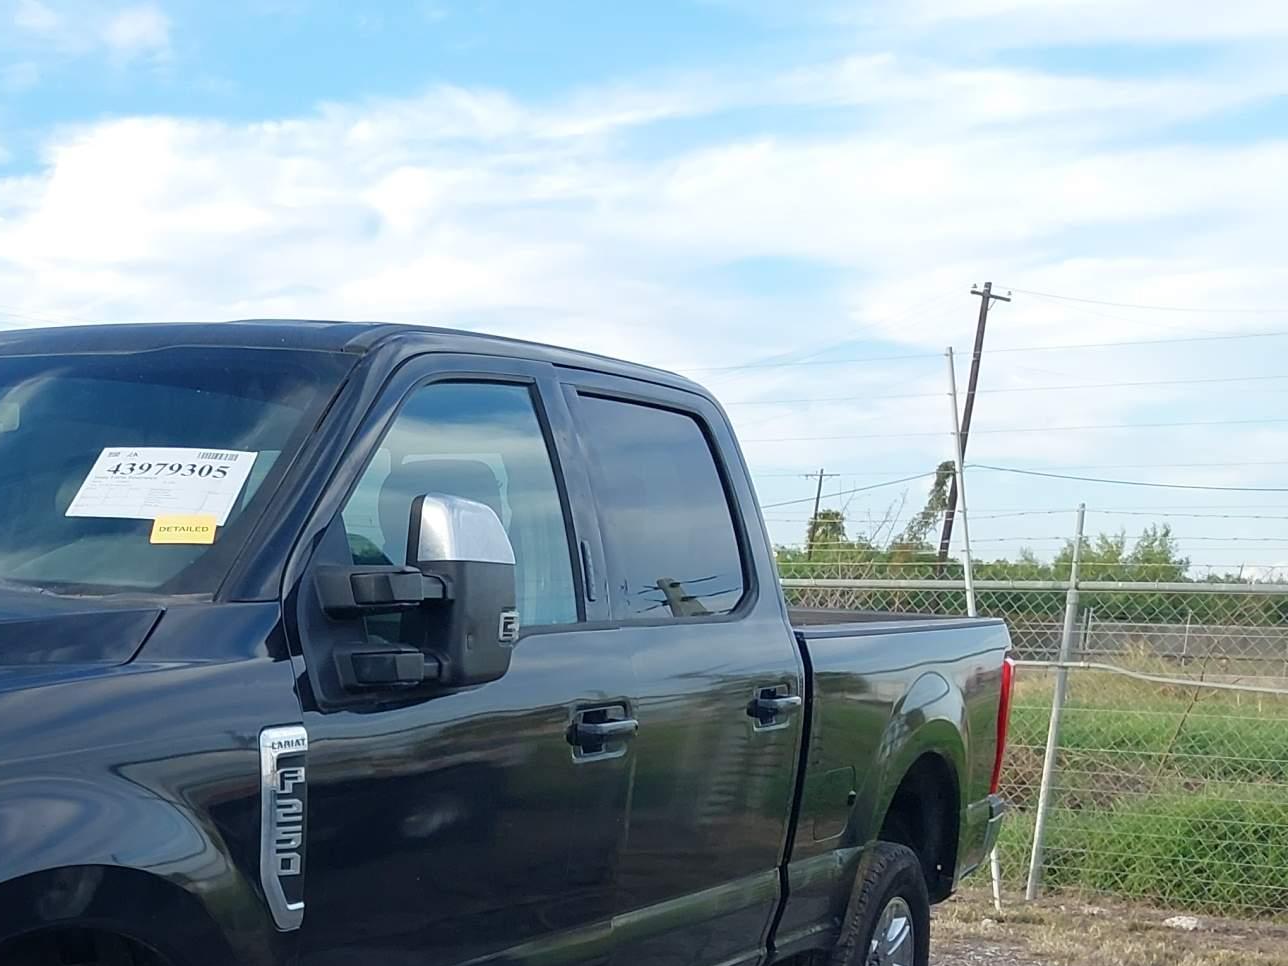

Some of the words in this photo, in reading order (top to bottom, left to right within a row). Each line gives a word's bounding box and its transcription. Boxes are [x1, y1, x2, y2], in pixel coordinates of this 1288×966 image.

[107, 462, 230, 478] 43979305
[159, 525, 209, 533] DETAILED
[271, 738, 306, 750] LARIAT
